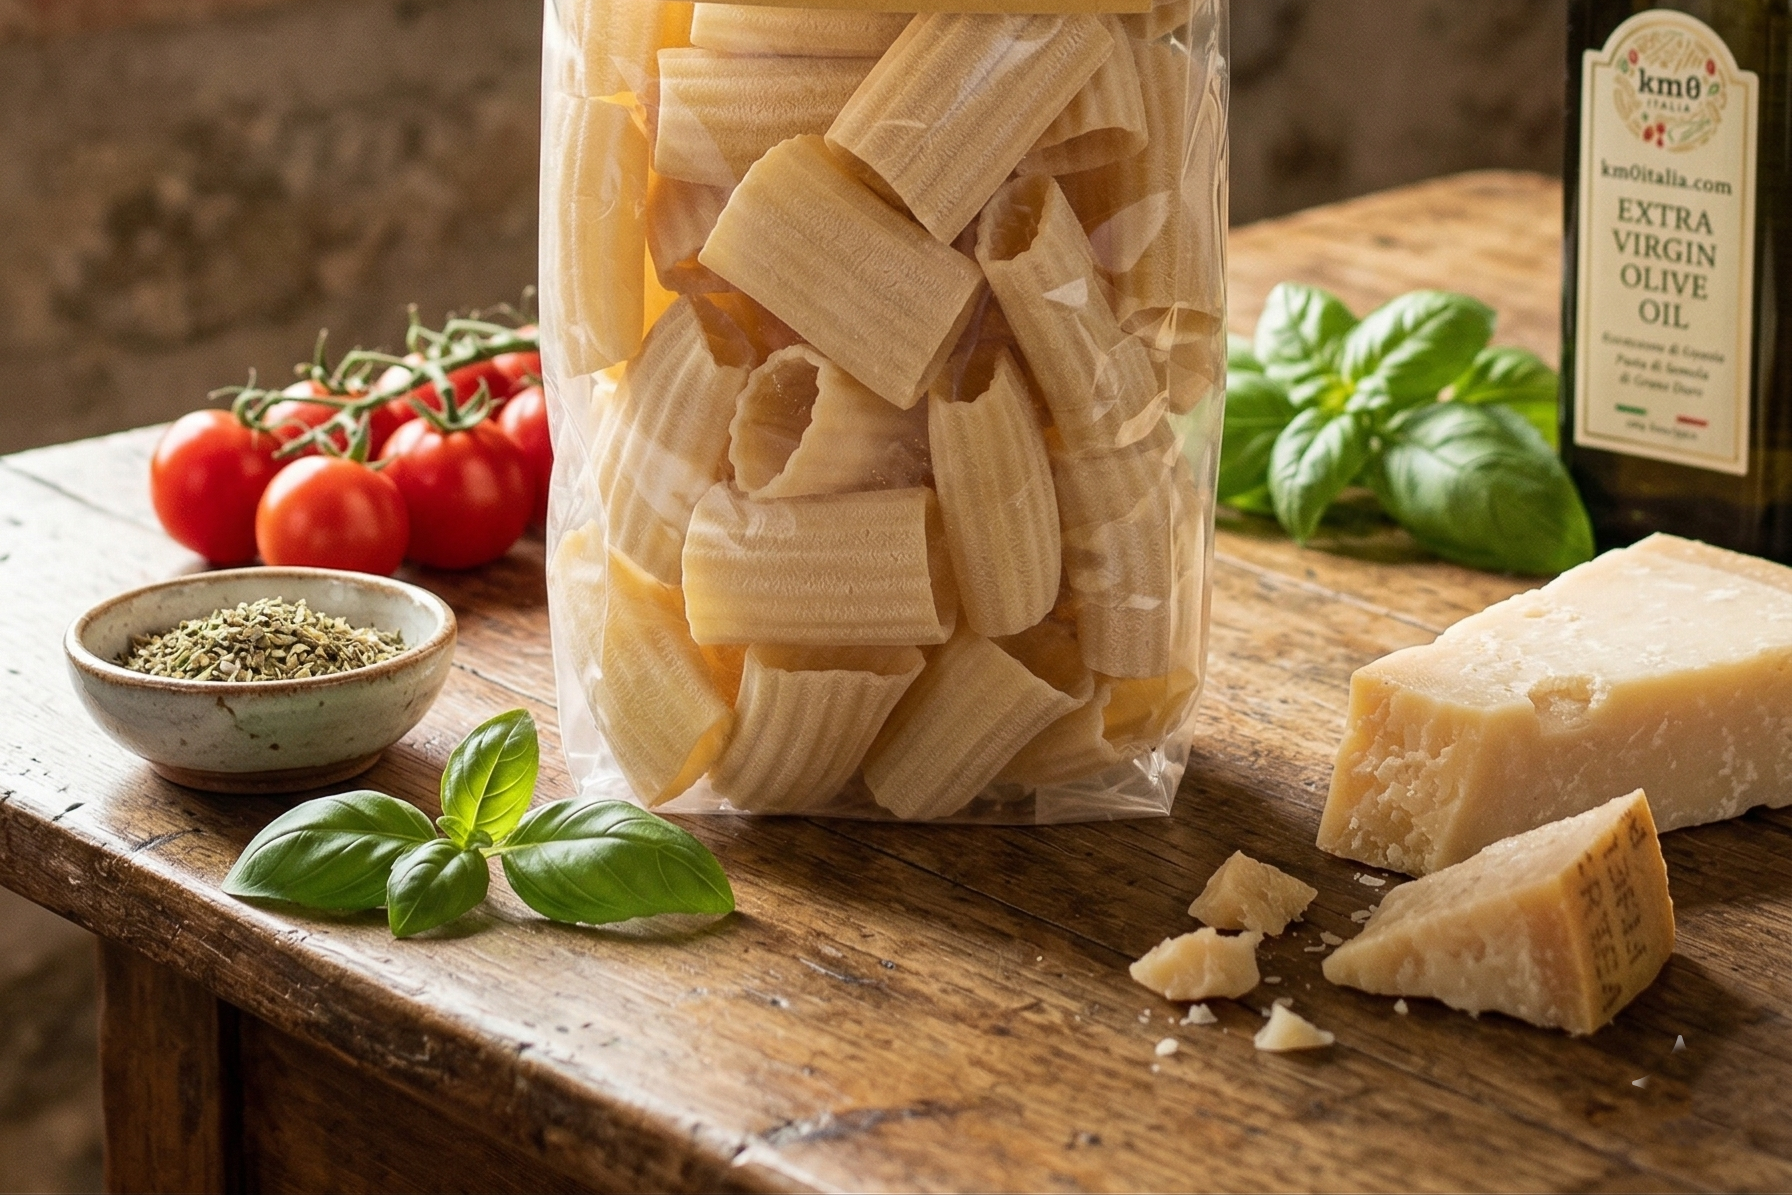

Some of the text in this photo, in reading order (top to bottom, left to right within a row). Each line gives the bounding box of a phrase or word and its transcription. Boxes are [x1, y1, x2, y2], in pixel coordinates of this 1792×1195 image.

[1638, 67, 1702, 100] km0
[1601, 158, 1732, 196] km0italia.com
[1618, 196, 1714, 236] EXTRA
[1612, 227, 1717, 268] VIRGIN
[1620, 262, 1708, 301] OLIVE
[1638, 297, 1690, 330] OIL
